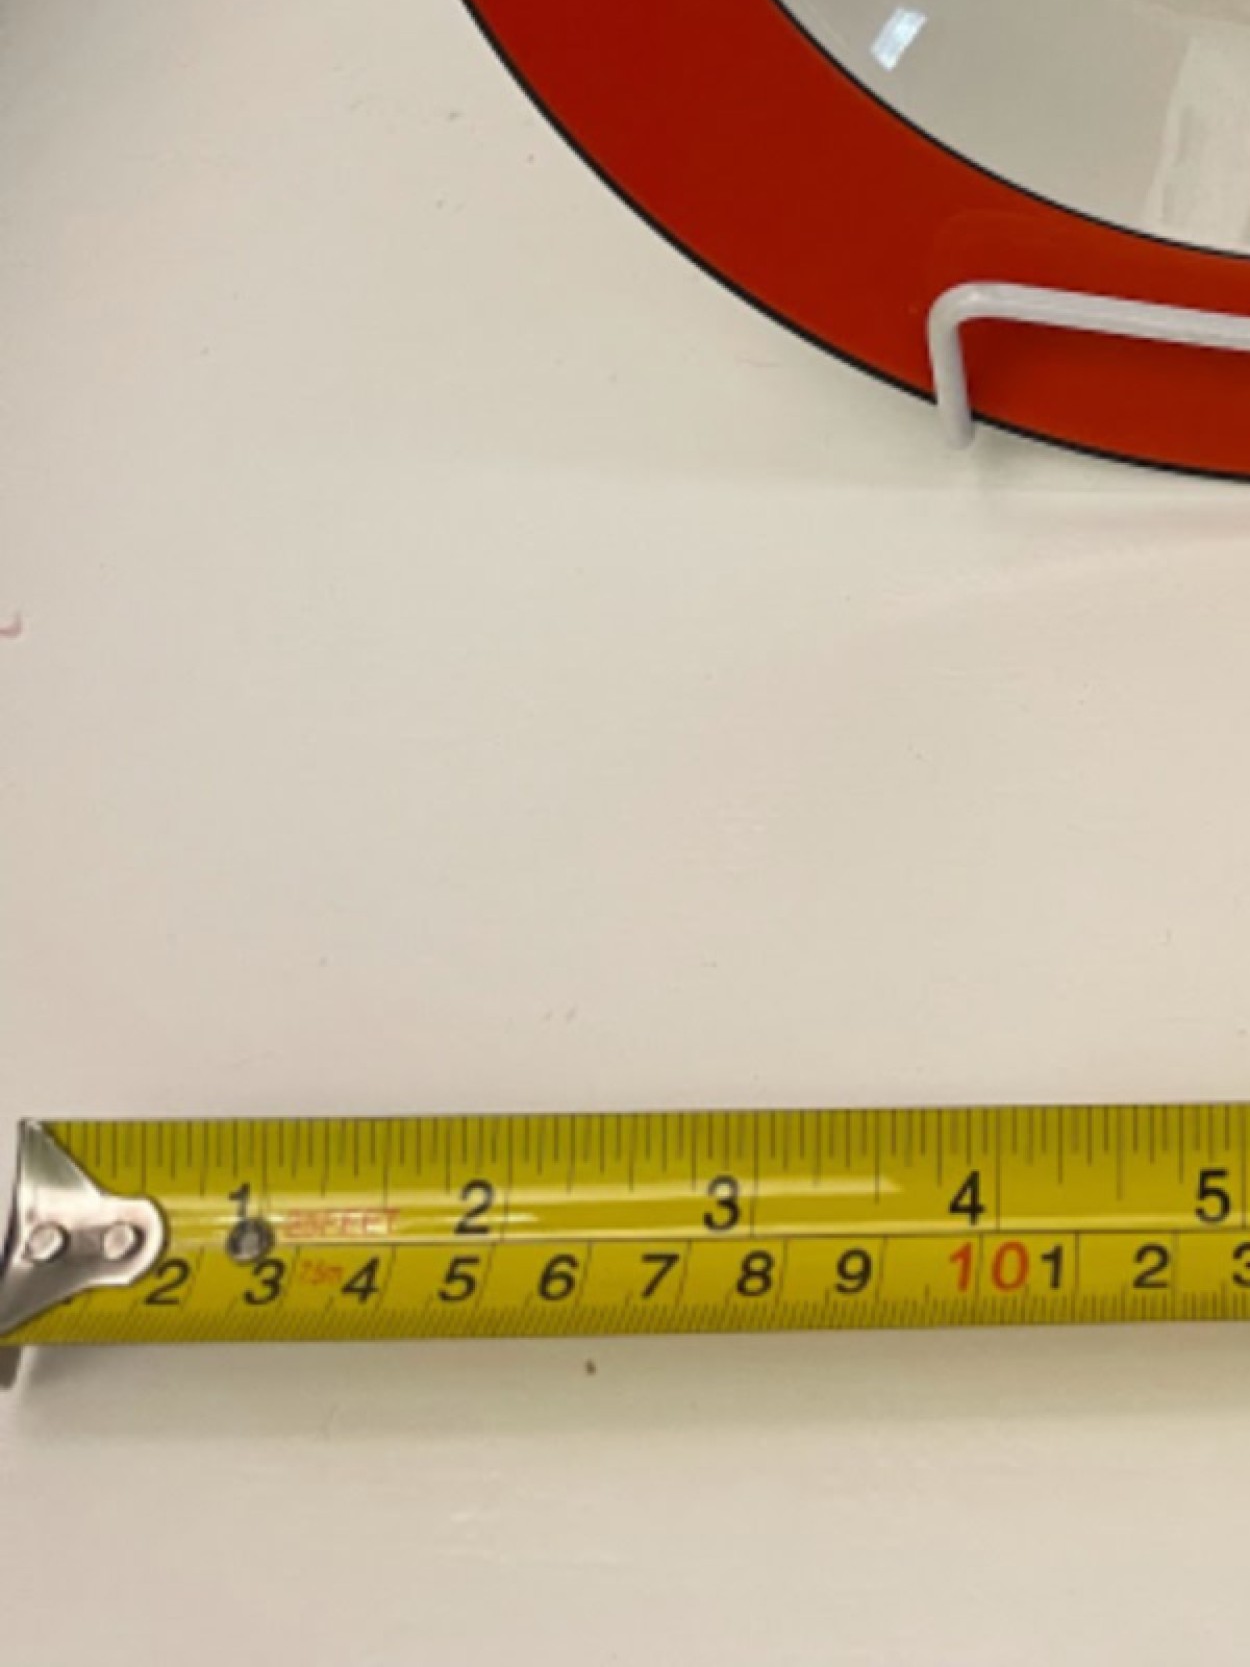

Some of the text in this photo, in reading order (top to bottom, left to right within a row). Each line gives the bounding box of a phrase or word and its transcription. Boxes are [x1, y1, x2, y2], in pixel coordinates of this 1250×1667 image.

[455, 1179, 496, 1234] 2
[703, 1175, 742, 1232] 3
[948, 1170, 986, 1226] 4
[1196, 1168, 1232, 1223] 5
[145, 1259, 190, 1306] 2
[244, 1258, 286, 1305] 3
[341, 1256, 380, 1302] 4
[438, 1256, 479, 1302] 5
[537, 1255, 578, 1301] 6
[640, 1253, 680, 1299] 7
[736, 1251, 775, 1297] 8
[836, 1248, 873, 1294] 9
[948, 1240, 1029, 1294] 10
[1041, 1244, 1063, 1290] 1
[1133, 1243, 1170, 1289] 2
